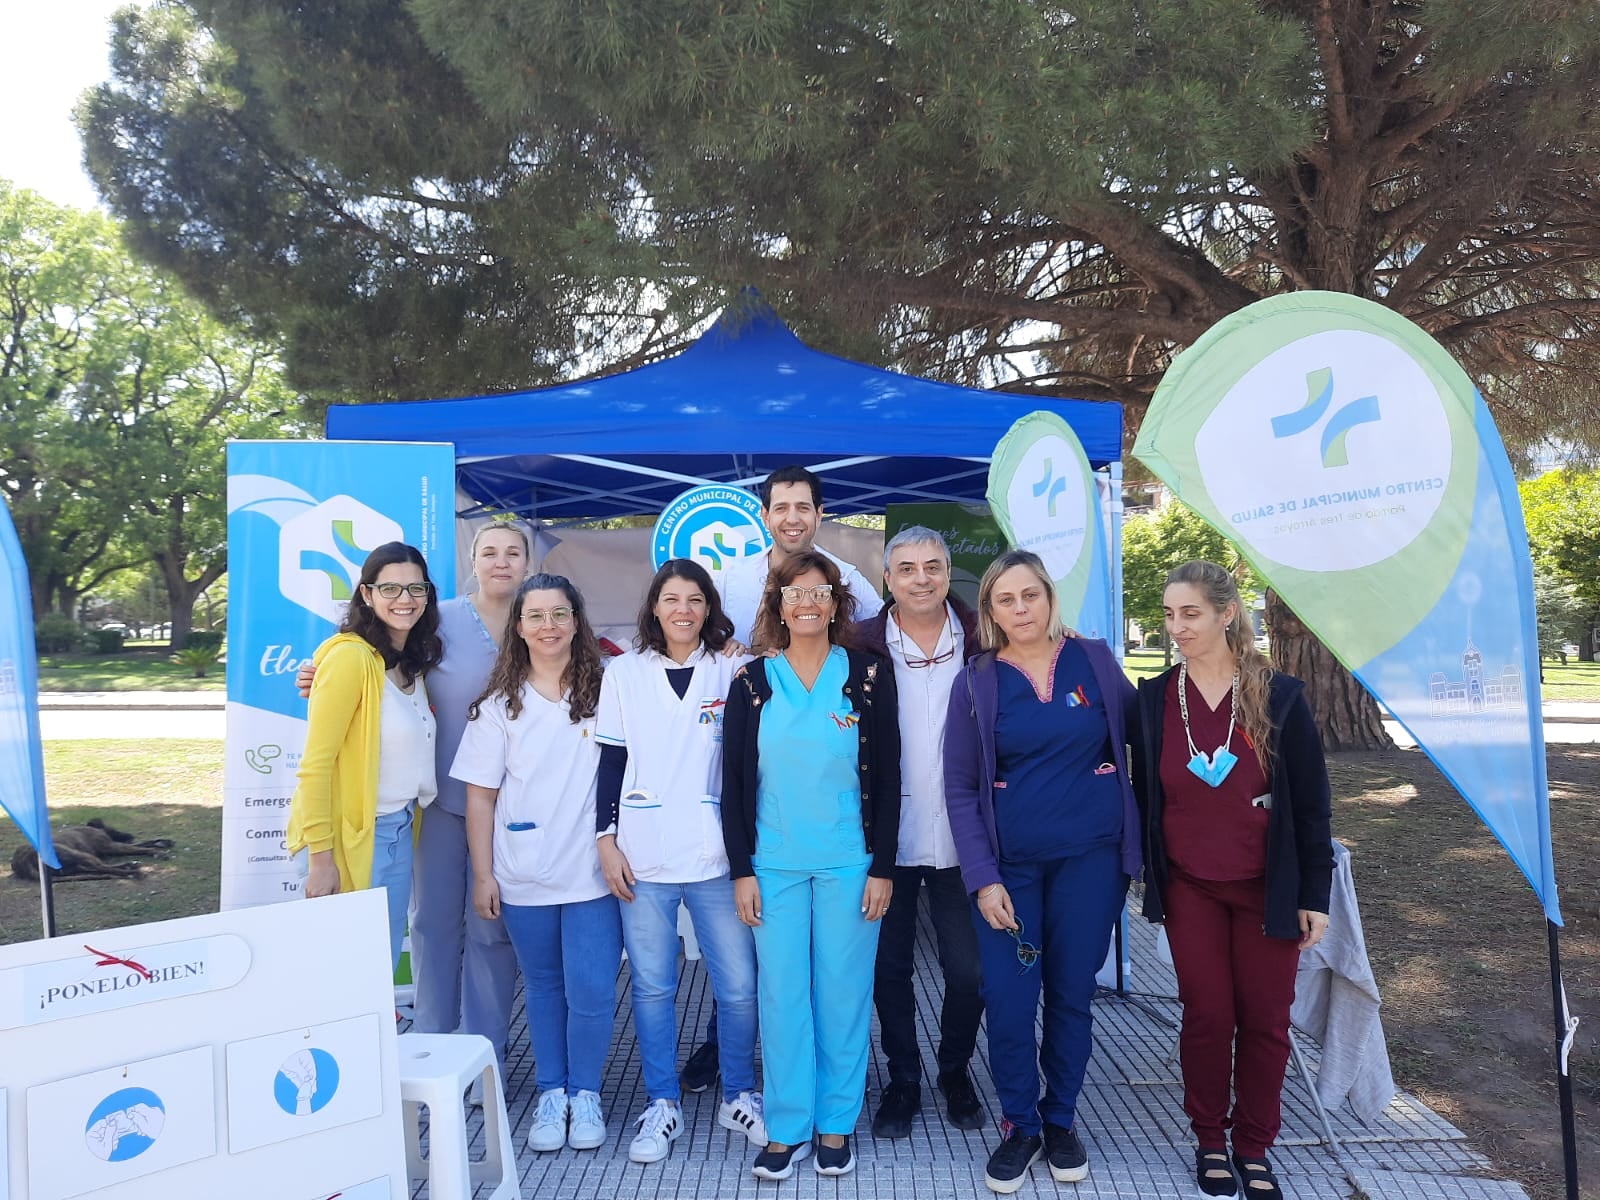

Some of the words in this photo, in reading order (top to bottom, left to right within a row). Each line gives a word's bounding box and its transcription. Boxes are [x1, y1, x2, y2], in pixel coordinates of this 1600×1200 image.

[421, 497, 428, 506] DE
[661, 502, 689, 535] CENTRO
[688, 491, 742, 505] MUNICIPAL
[743, 499, 757, 512] DE
[244, 797, 292, 809] Emerge
[246, 829, 287, 839] Conm
[40, 972, 142, 1010] ¡PONELO
[149, 960, 204, 985] BIEN!
